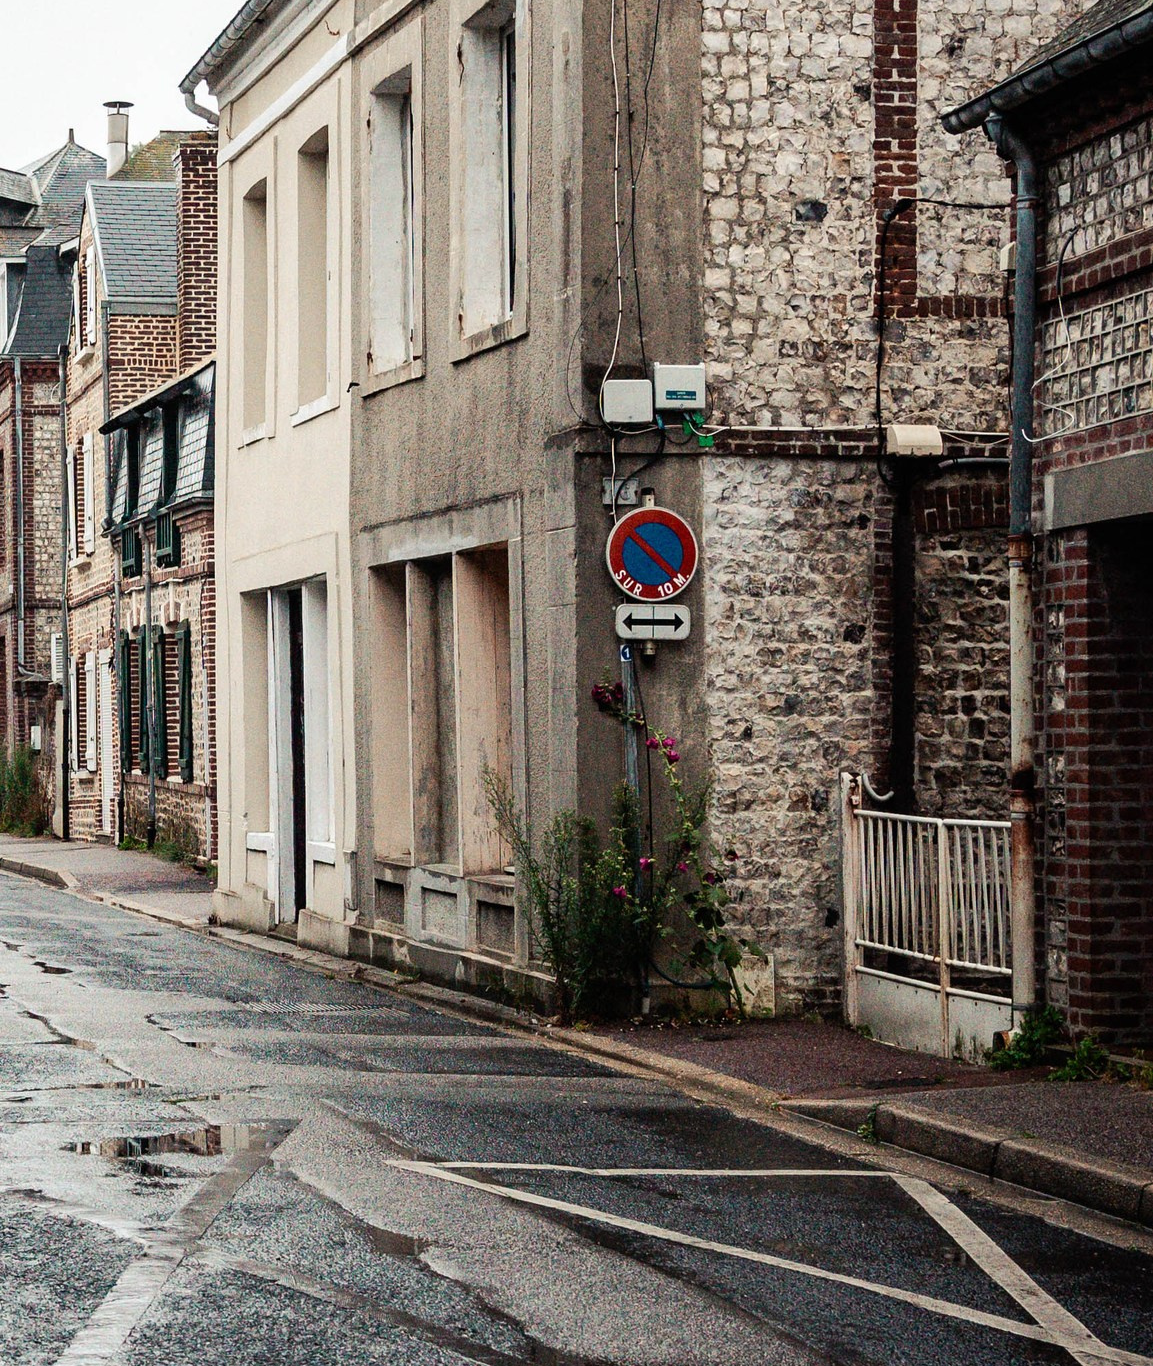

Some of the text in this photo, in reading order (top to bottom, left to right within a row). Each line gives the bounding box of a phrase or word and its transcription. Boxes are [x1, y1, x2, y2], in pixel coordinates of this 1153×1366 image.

[615, 570, 690, 597] SUR 10 M.
[623, 647, 630, 658] 1
